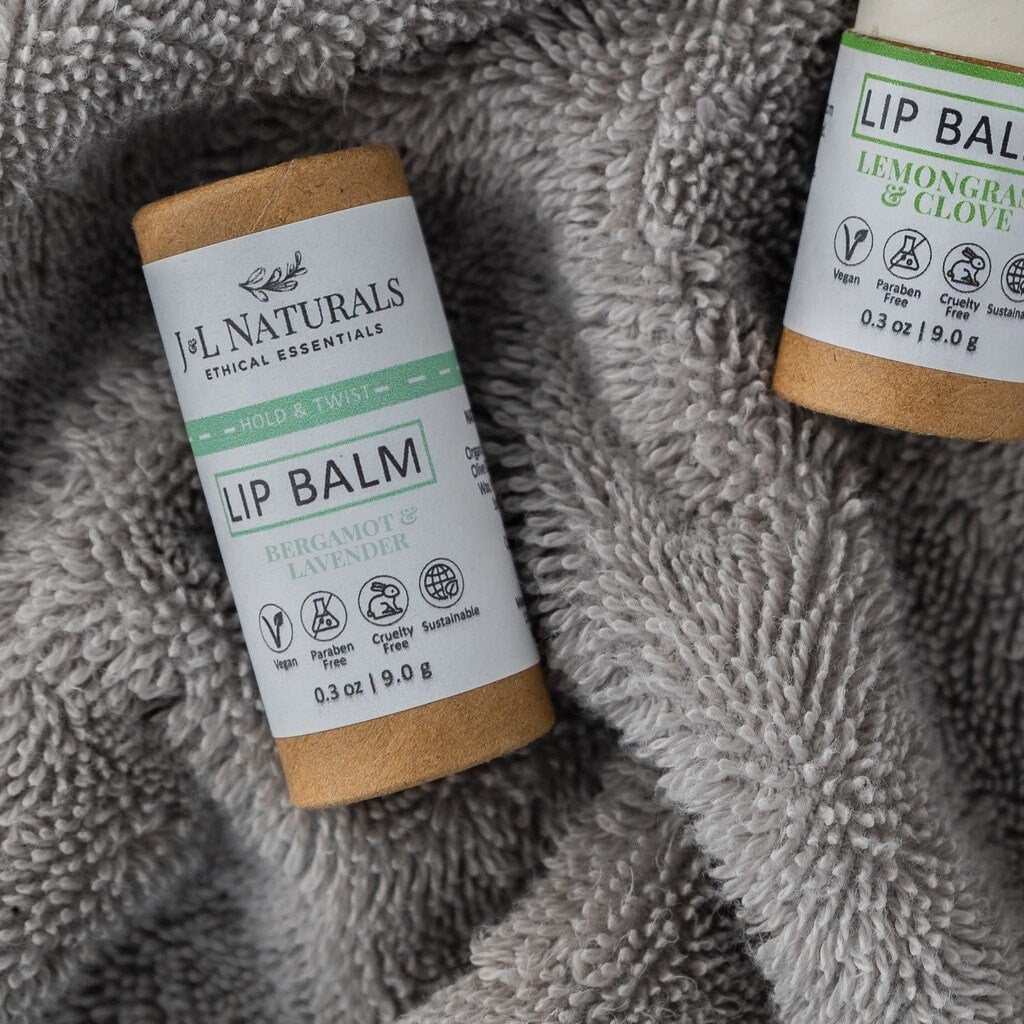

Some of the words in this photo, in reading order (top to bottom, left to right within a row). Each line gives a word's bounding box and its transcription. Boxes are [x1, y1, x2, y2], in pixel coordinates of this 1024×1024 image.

[861, 89, 919, 134] LIP
[881, 184, 906, 207] &
[913, 191, 1015, 232] CLOVE
[833, 268, 860, 285] Vegan
[877, 279, 921, 298] Paraben
[884, 292, 908, 308] Free
[940, 293, 980, 312] Cruelty
[945, 307, 970, 320] Free
[175, 325, 220, 373] J&L
[223, 276, 405, 352] NATURALS
[861, 309, 887, 329] 0.3
[892, 320, 912, 335] oz
[931, 325, 962, 346] 9.0
[966, 335, 979, 352] g
[205, 355, 269, 380] ETHICAL
[277, 323, 383, 360] ESSENTIALS
[240, 406, 286, 432] HOLD
[293, 402, 307, 417] &
[312, 384, 371, 414] TWIST
[223, 479, 270, 522] LIP
[289, 437, 421, 507] BALM
[265, 513, 395, 563] BERGAMOT
[400, 506, 419, 525] &
[288, 533, 411, 580] LAVENDER
[422, 604, 480, 632] Sustainable
[372, 624, 414, 645] Cruelty
[383, 639, 409, 655] Free
[274, 657, 298, 670] Vegan
[311, 642, 354, 661] Paraben
[324, 656, 347, 670] Free
[314, 684, 340, 704] 0.3
[344, 684, 363, 697] oz
[382, 663, 413, 686] 9.0
[420, 661, 432, 679] g
